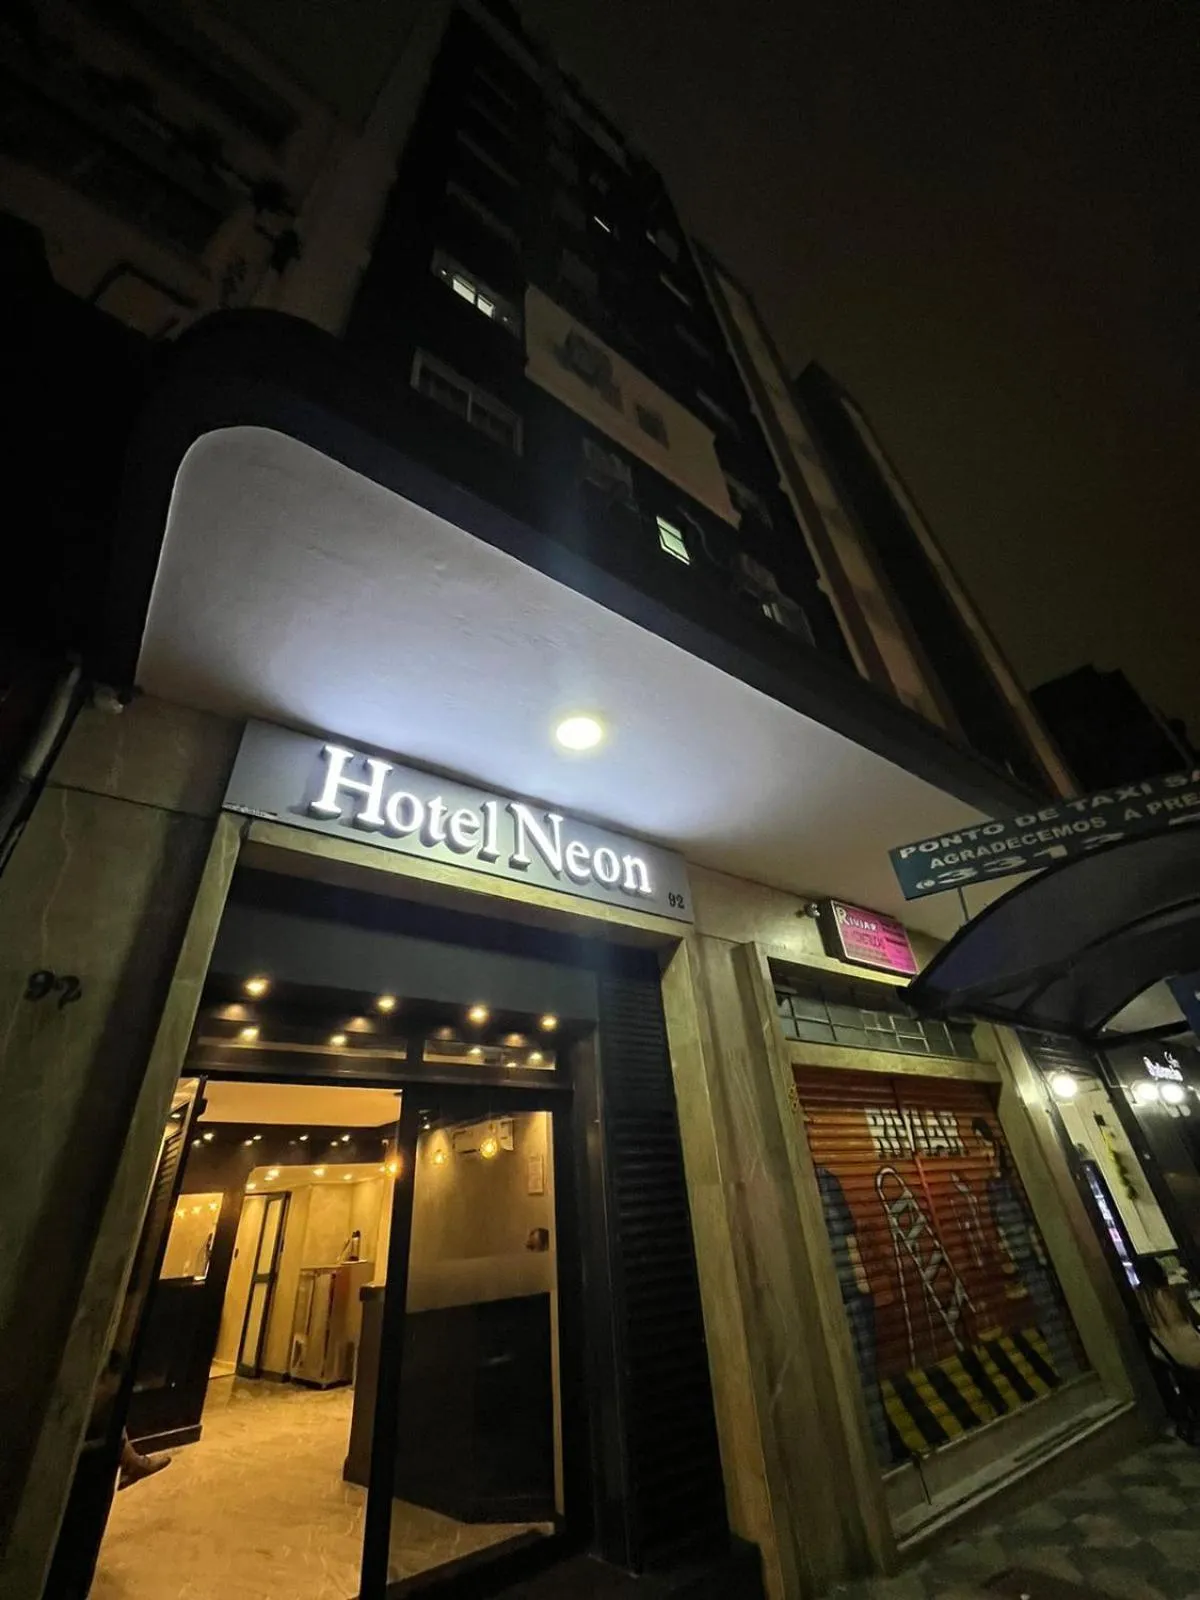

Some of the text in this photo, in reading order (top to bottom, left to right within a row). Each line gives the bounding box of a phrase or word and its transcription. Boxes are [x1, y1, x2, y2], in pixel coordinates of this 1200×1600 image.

[310, 744, 653, 893] Hotel Neon
[899, 823, 1005, 859] PONTO
[1015, 808, 1060, 828] DE
[1066, 781, 1153, 812] TAXI
[930, 816, 1107, 869] AGRADECEMOS
[1124, 808, 1144, 821] A
[668, 891, 685, 909] 92
[23, 969, 82, 1011] 92
